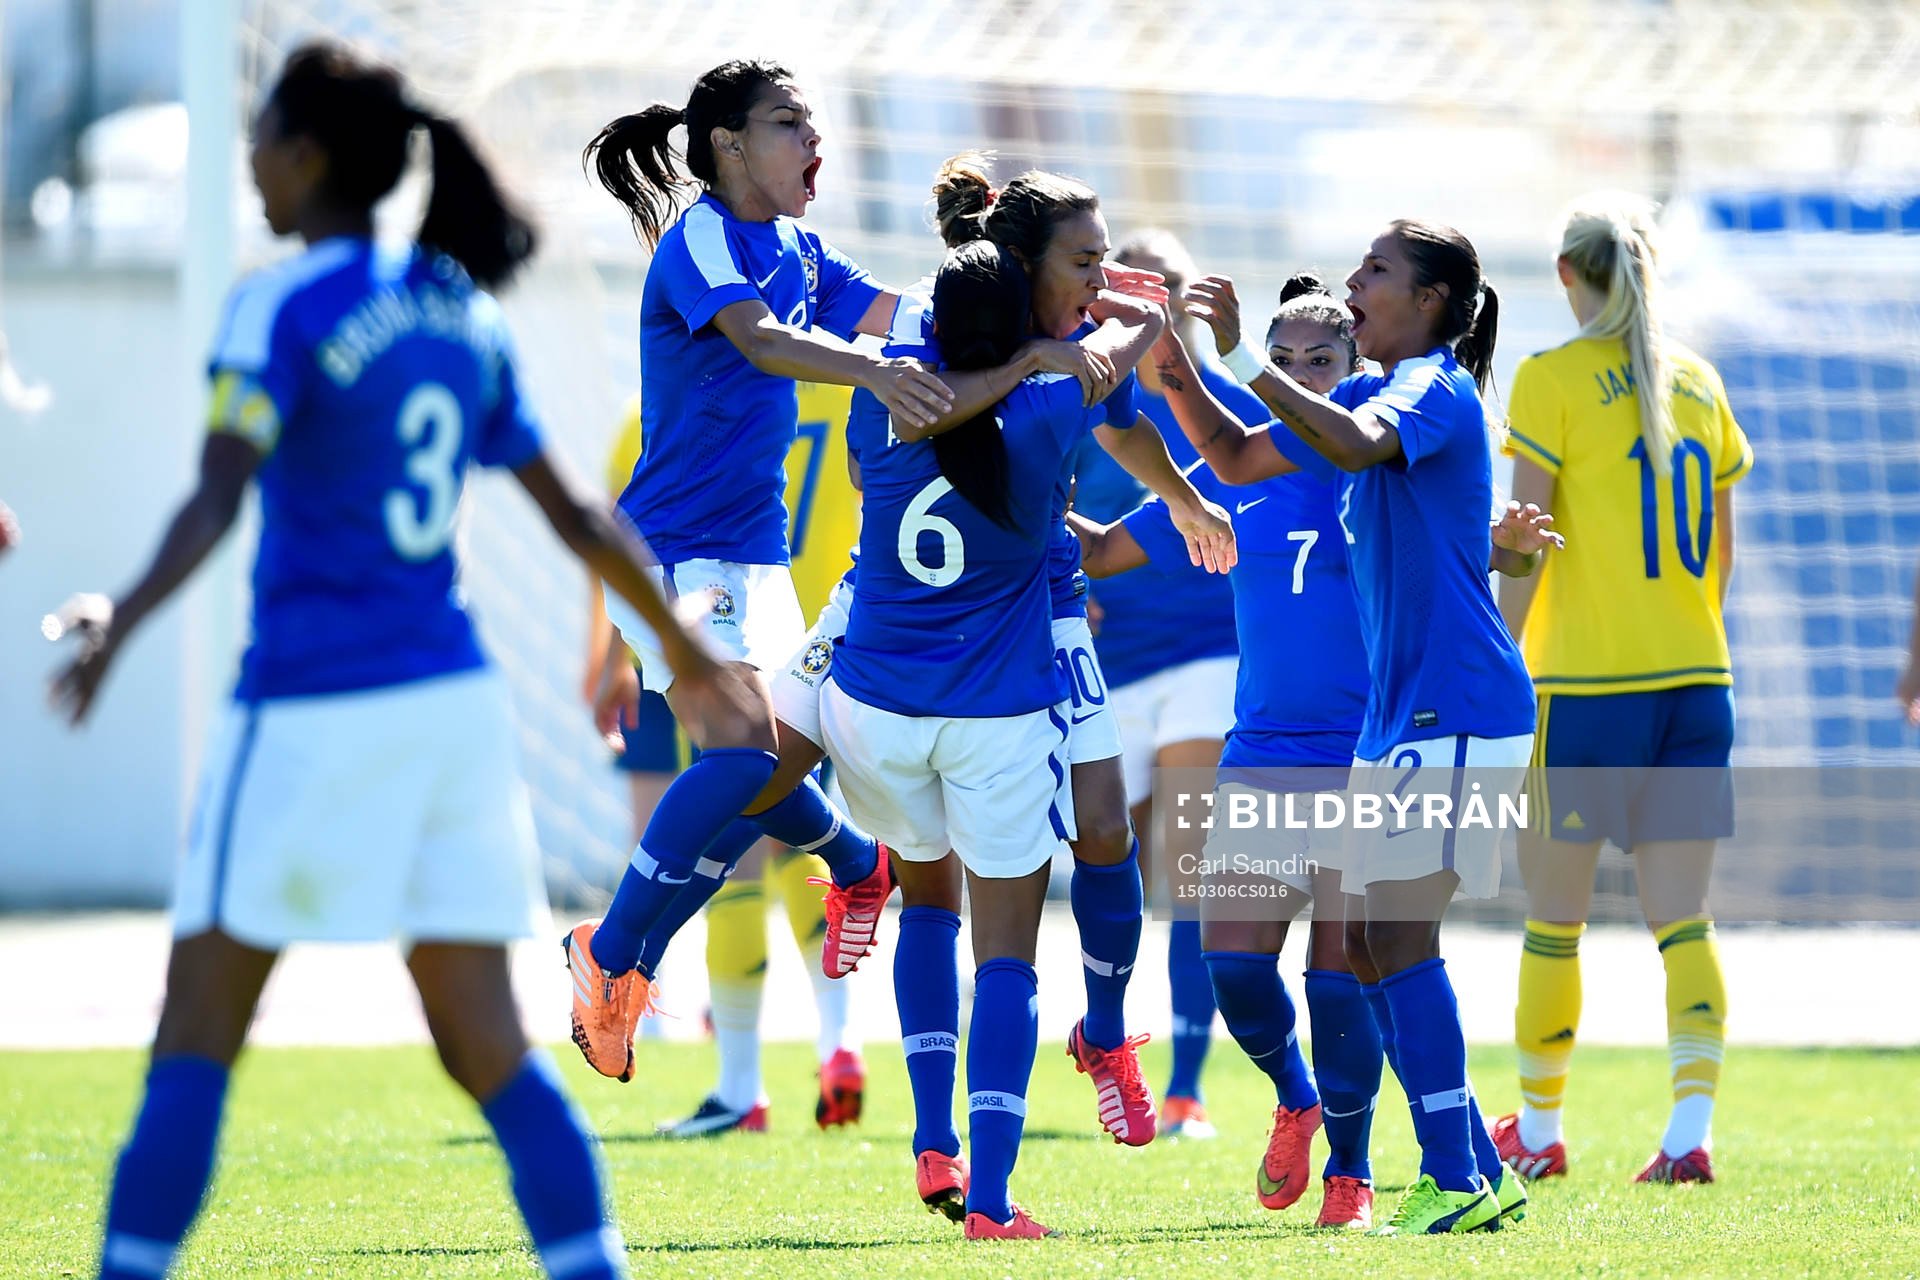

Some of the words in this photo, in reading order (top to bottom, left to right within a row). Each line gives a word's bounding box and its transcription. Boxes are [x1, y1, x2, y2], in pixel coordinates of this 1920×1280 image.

[384, 381, 463, 562] 3
[897, 475, 965, 588] 6
[1627, 436, 1714, 579] 10
[1286, 529, 1319, 595] 7
[790, 669, 815, 688] BRASIL
[1054, 646, 1106, 709] 10
[1388, 748, 1422, 813] 2
[971, 1096, 1008, 1108] BRASIL
